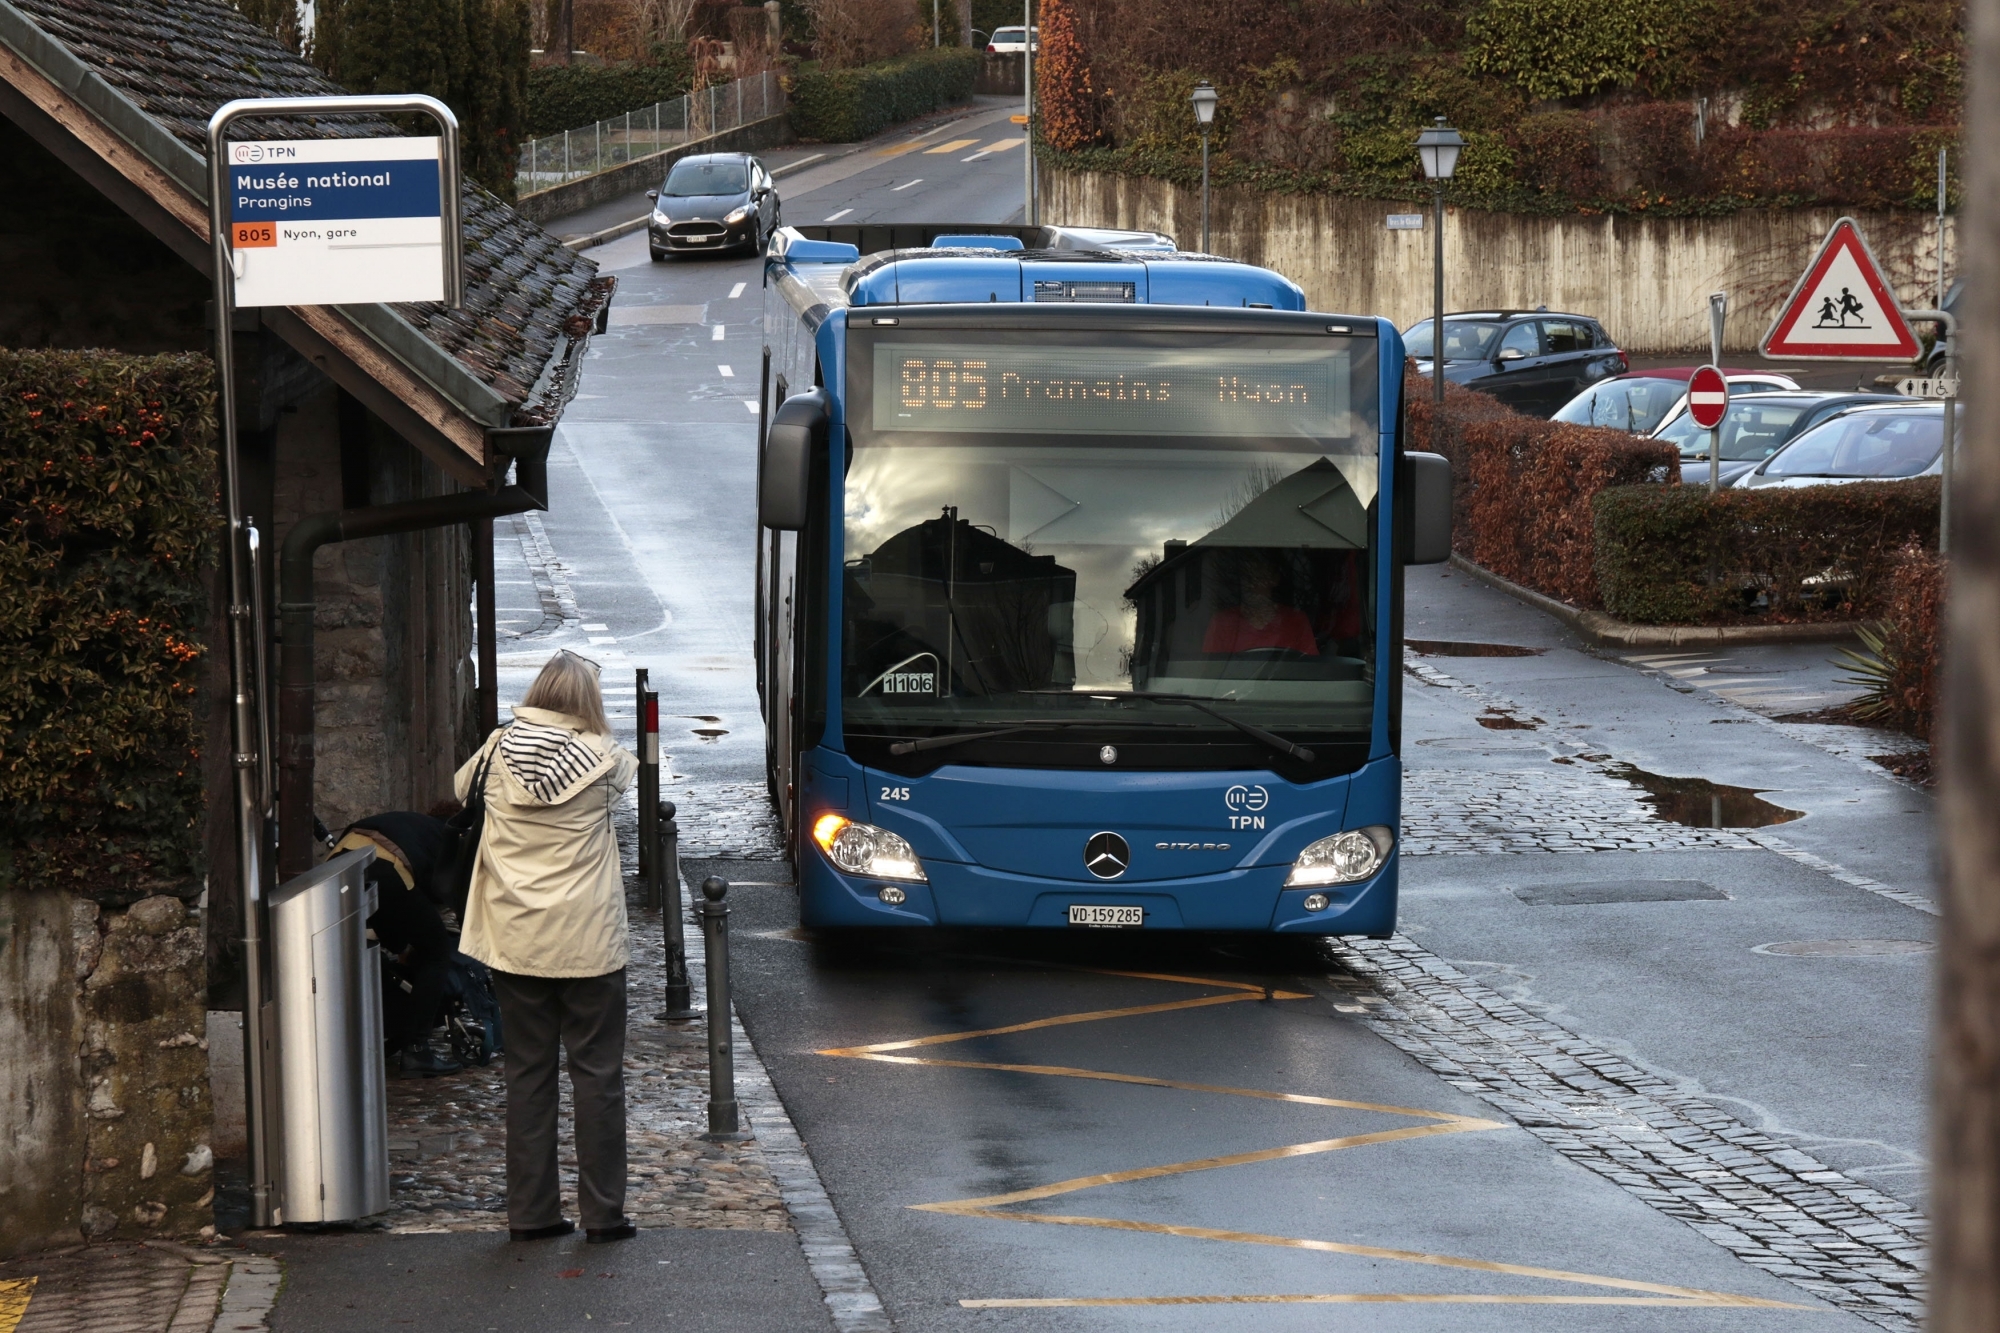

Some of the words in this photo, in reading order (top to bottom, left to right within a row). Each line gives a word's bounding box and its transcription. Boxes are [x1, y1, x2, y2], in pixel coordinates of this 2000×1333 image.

[267, 147, 296, 158] TPN
[237, 172, 299, 190] Musée
[307, 171, 391, 188] national
[238, 194, 312, 211] Prangins
[238, 229, 271, 242] 805
[283, 229, 321, 240] Nyon,
[326, 229, 357, 240] gare
[902, 360, 987, 408] 805
[884, 677, 933, 692] 1106
[880, 786, 910, 801] 245
[1228, 815, 1265, 830] TPN
[1155, 842, 1231, 851] CITARO
